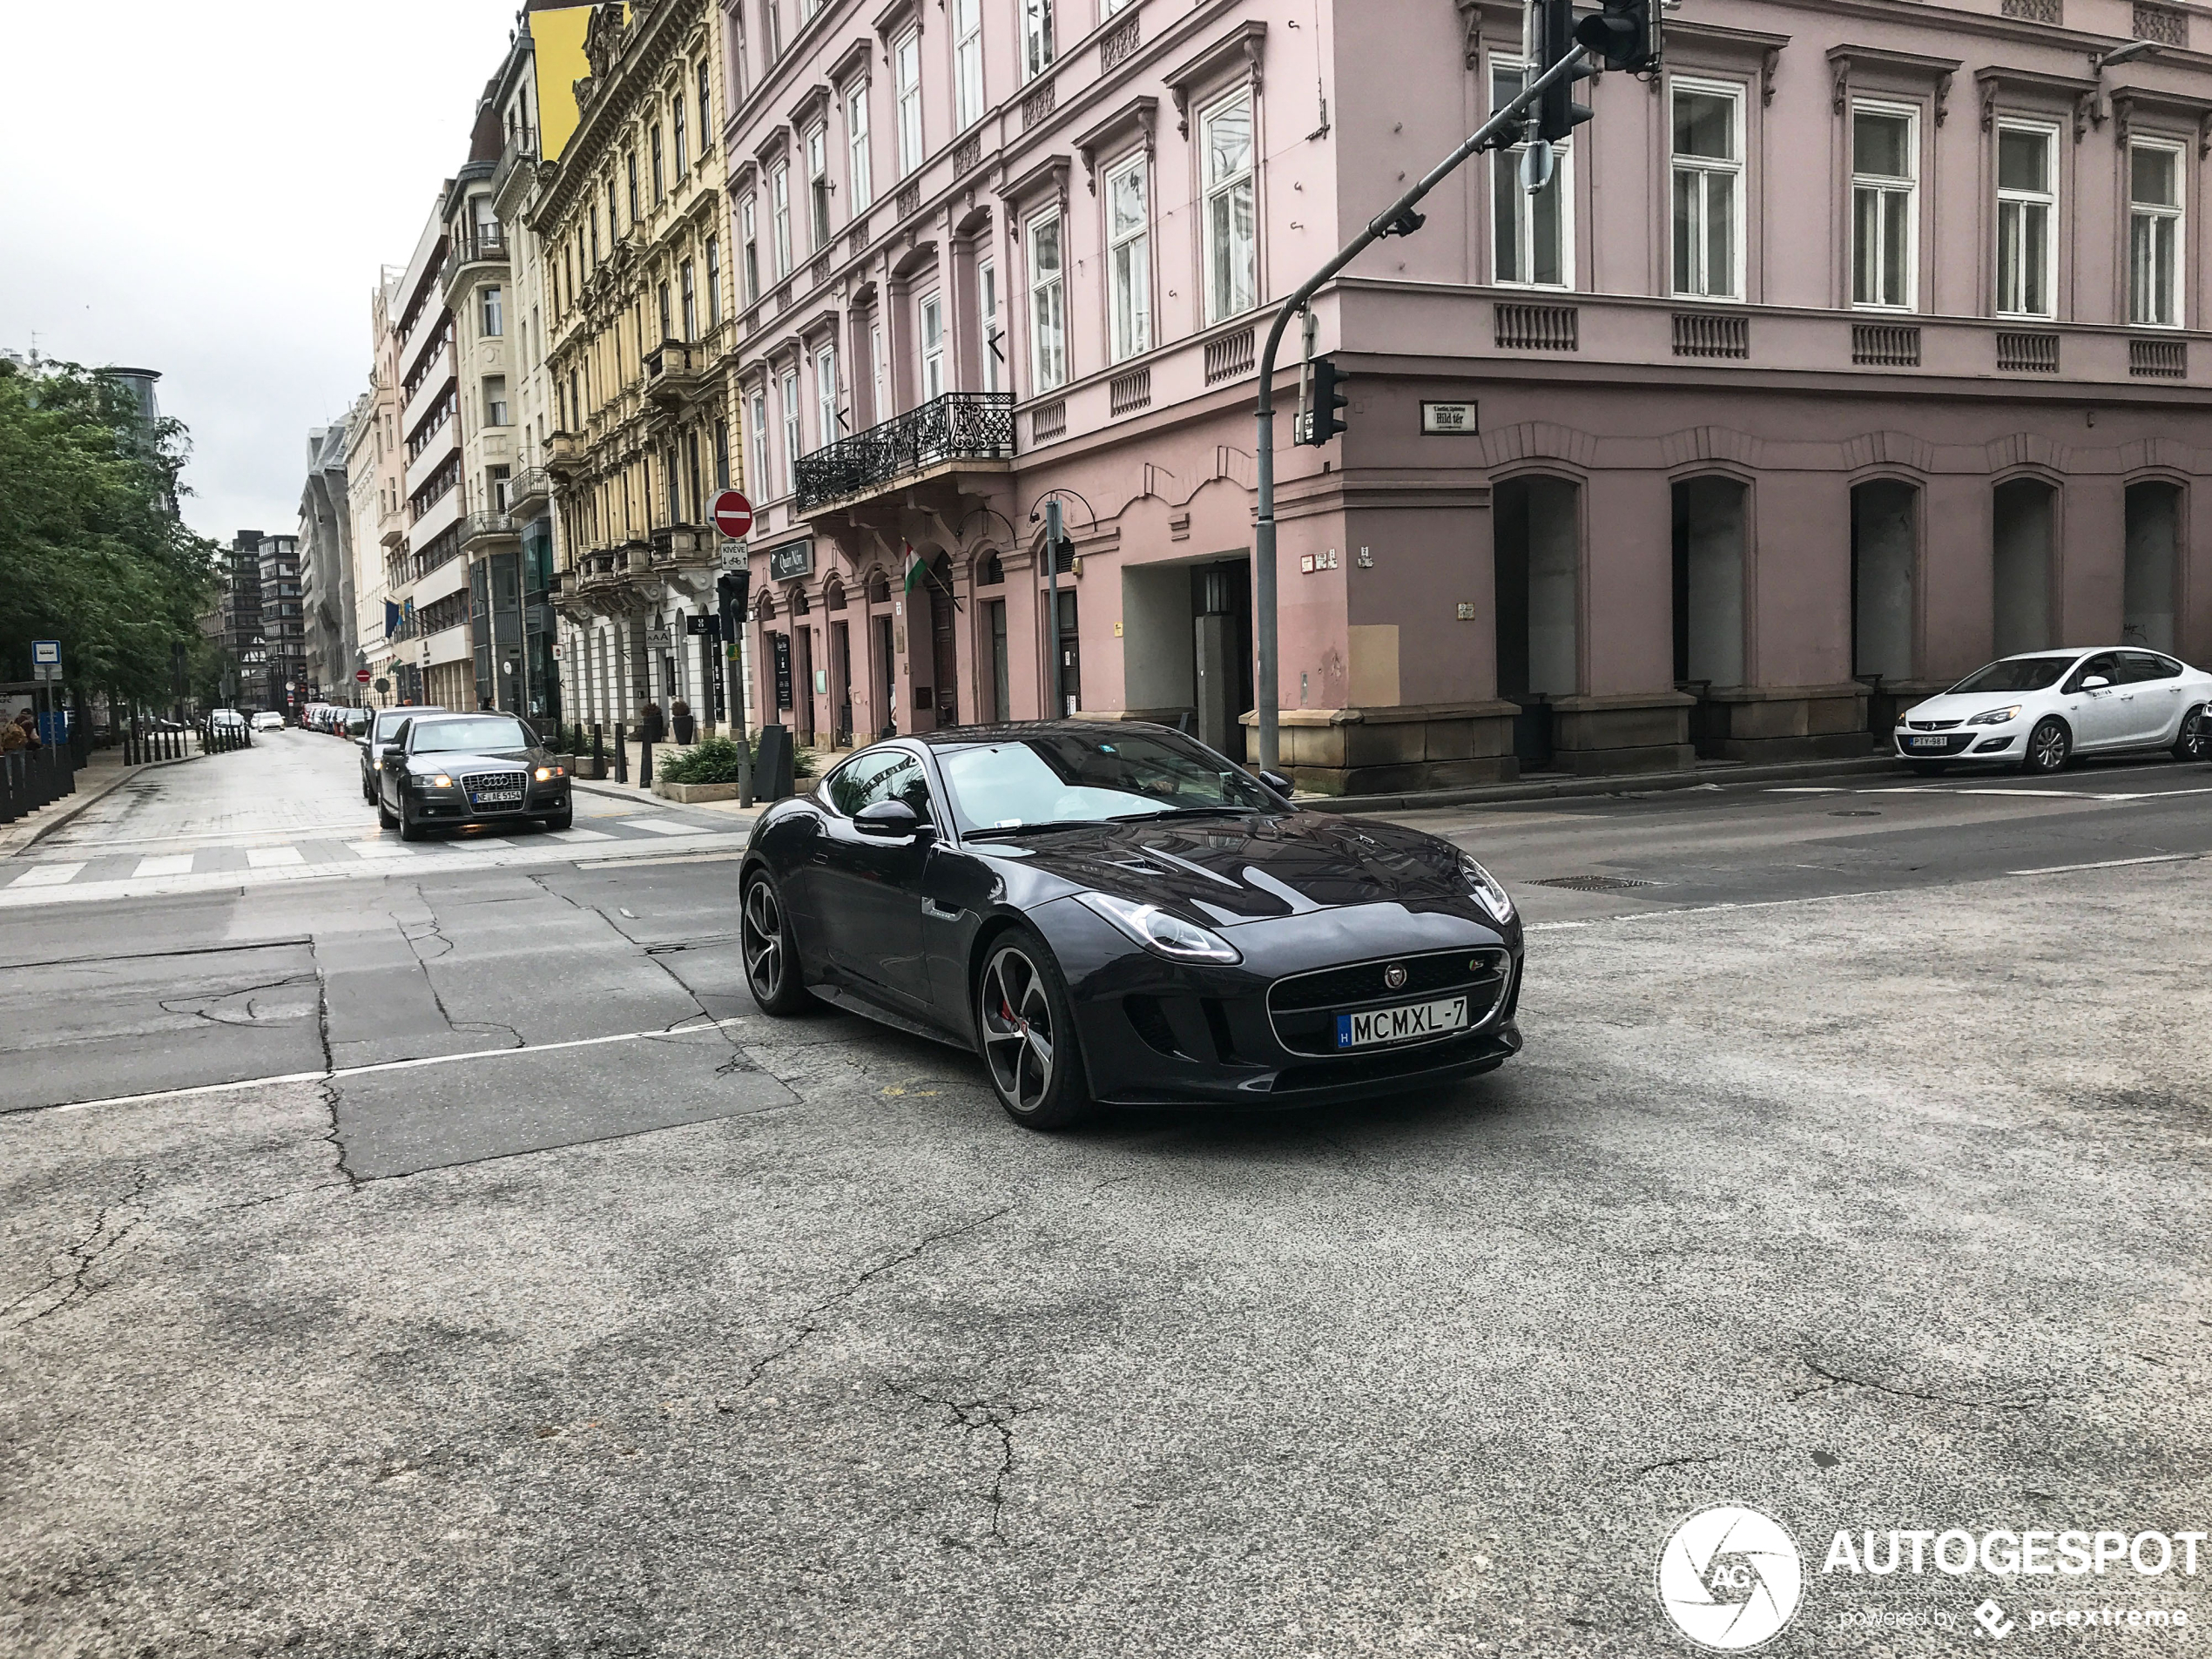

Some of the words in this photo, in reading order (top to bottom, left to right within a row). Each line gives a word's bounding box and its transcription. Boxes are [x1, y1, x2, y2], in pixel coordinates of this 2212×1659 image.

[1436, 412, 1452, 424] Hild
[1453, 413, 1464, 424] tér
[1914, 737, 1946, 745] PTY-981
[502, 791, 521, 799] 5154
[1340, 1033, 1348, 1042] H
[1353, 999, 1465, 1042] MCMXL-7
